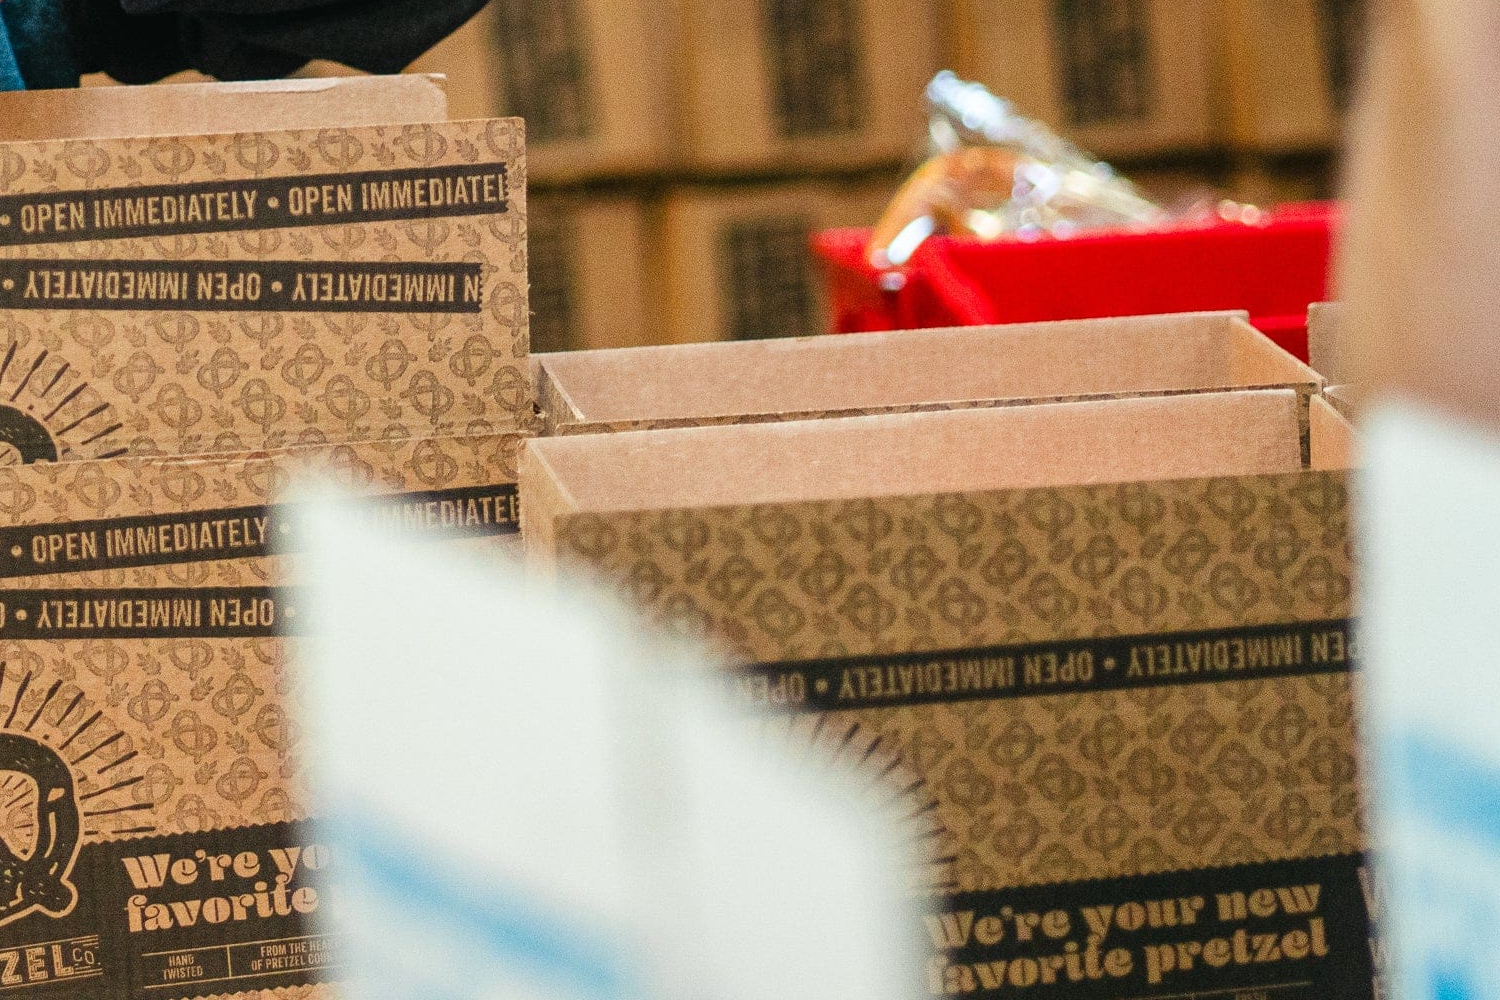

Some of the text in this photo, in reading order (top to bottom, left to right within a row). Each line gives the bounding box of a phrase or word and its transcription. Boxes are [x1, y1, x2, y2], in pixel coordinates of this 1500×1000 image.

[20, 200, 84, 233] OPEN
[94, 190, 257, 228] IMMEDIATELY
[288, 183, 351, 216] OPEN
[24, 270, 188, 300] IMMEDIATELY
[197, 271, 261, 301] OPEN
[293, 272, 455, 302] IMMEDIATELY
[32, 532, 97, 563] OPEN
[106, 516, 268, 558] IMMEDIATELY
[37, 598, 200, 629] IMMEDIATELY
[211, 598, 274, 628] OPEN
[1023, 649, 1094, 686] OPEN
[1127, 635, 1301, 678] IMMEDIATELY
[840, 656, 1015, 700] IMMEDIATELY
[121, 844, 332, 889] We're yo
[124, 881, 320, 933] favorite
[925, 883, 1322, 950] We're your new
[251, 959, 263, 971] OF
[265, 954, 305, 969] PRETZEL
[260, 944, 287, 957] FROM
[290, 941, 307, 954] THE
[927, 940, 1134, 995] favorite
[1145, 917, 1330, 985] pretzel
[163, 965, 203, 980] TWISTED
